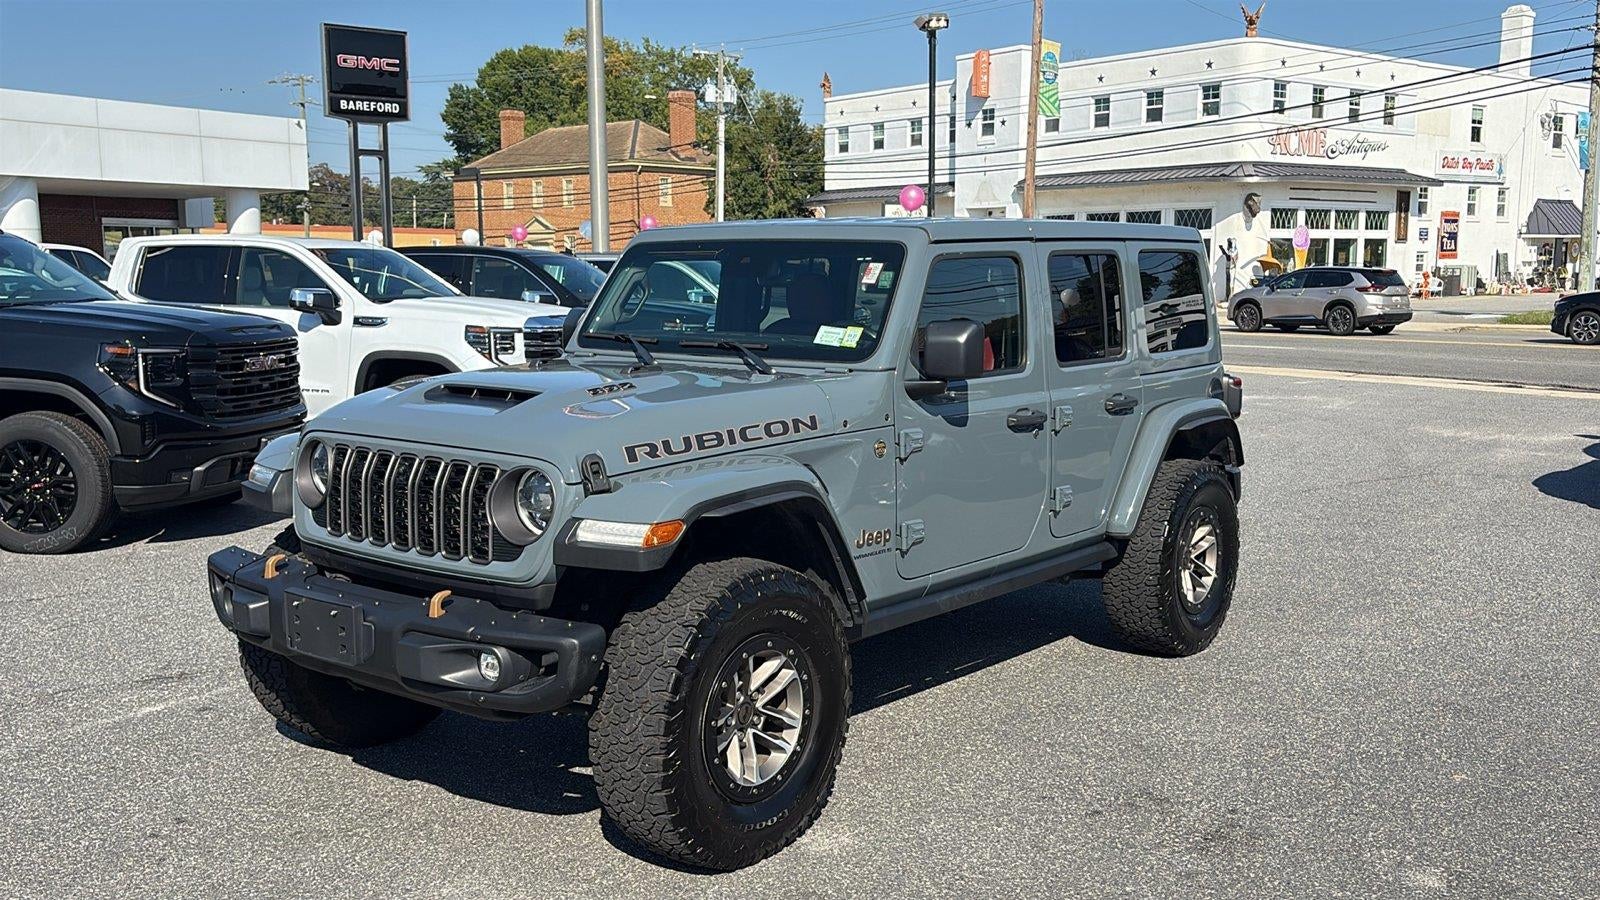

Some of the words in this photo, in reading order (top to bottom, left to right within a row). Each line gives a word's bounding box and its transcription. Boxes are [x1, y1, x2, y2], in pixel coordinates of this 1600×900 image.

[337, 54, 400, 72] GMC
[340, 99, 400, 114] BAREFORD
[1268, 127, 1327, 158] ACME
[1326, 132, 1389, 160] Antiques
[1441, 156, 1460, 169] Dutch
[1461, 157, 1474, 173] Boy
[1474, 157, 1495, 171] Paints
[1442, 238, 1455, 250] TEA
[244, 354, 286, 372] GMC
[624, 414, 819, 464] RUBICON
[855, 528, 891, 548] Jeep
